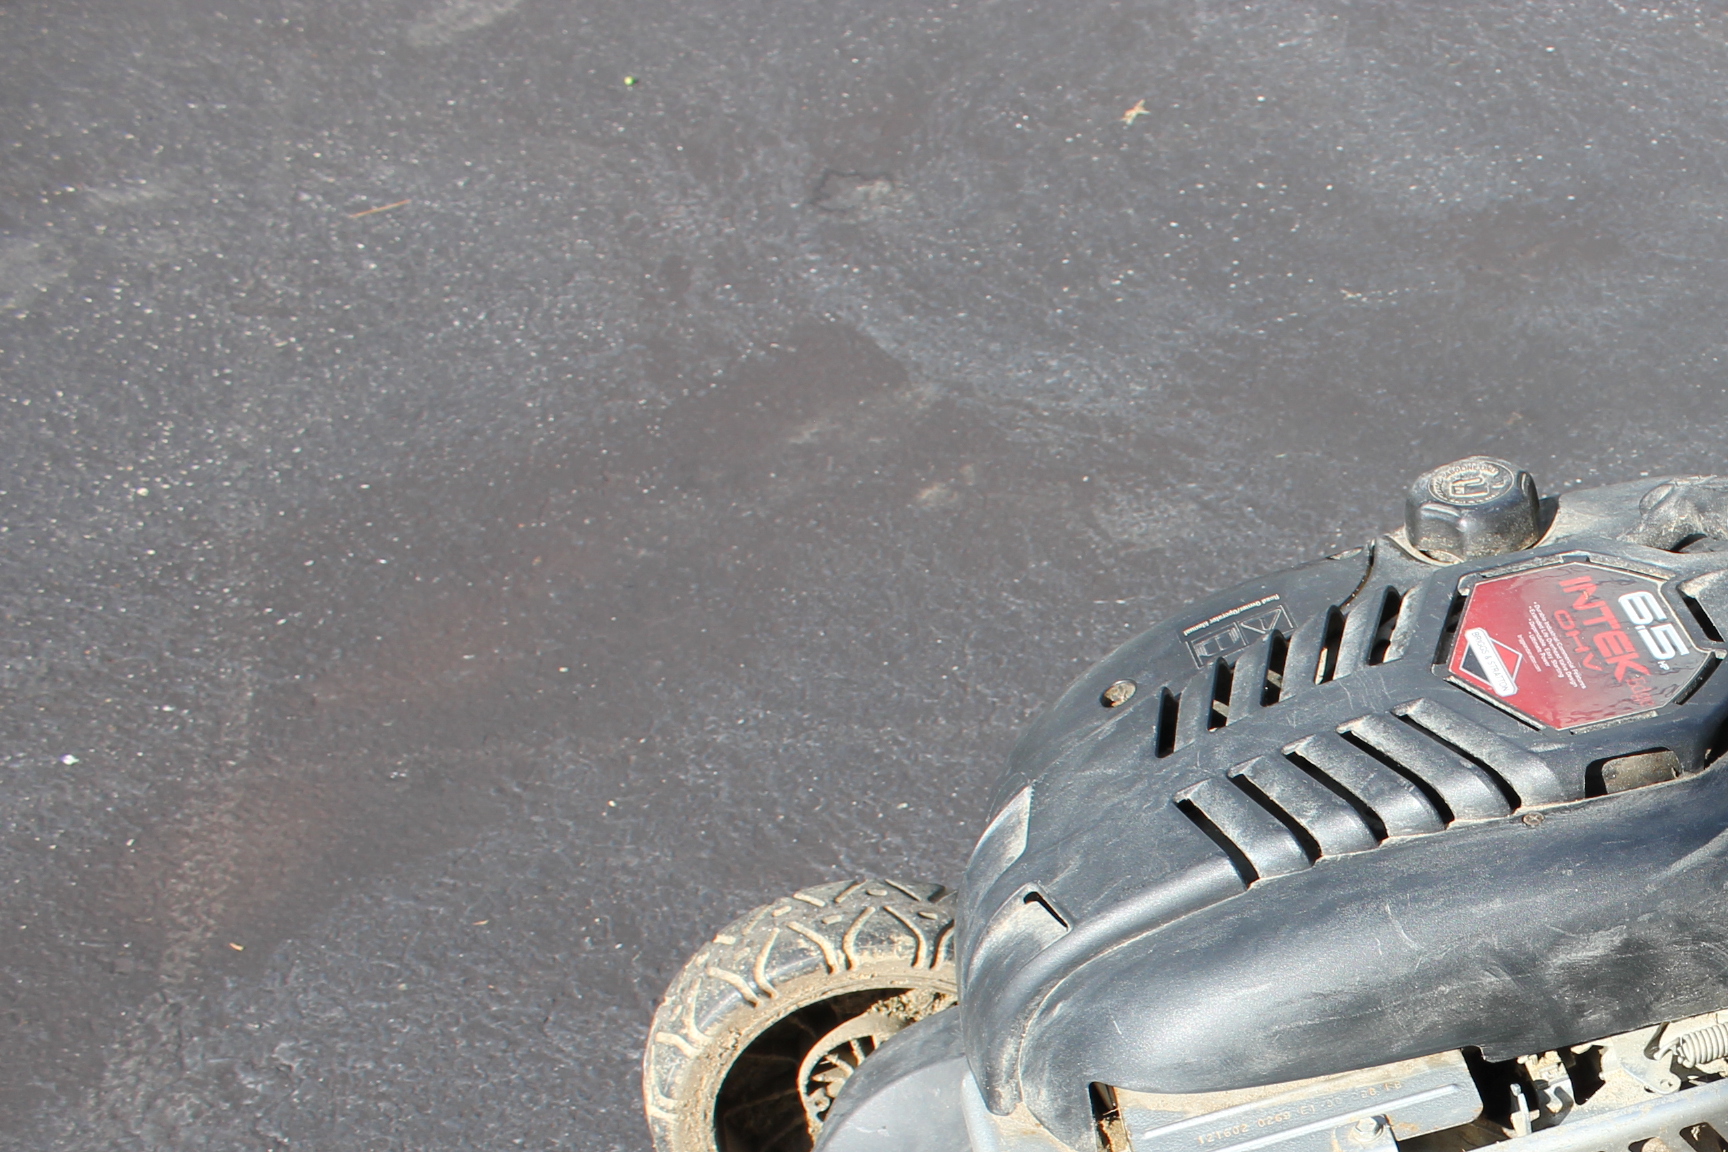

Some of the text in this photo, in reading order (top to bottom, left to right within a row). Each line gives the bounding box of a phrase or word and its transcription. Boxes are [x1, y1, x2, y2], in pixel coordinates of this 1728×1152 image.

[1469, 628, 1490, 656] BRIGGS
[1485, 658, 1512, 694] STRATTON
[1554, 610, 1603, 671] OHV
[1558, 576, 1651, 683] INTEK
[1196, 1122, 1249, 1145] 121602
